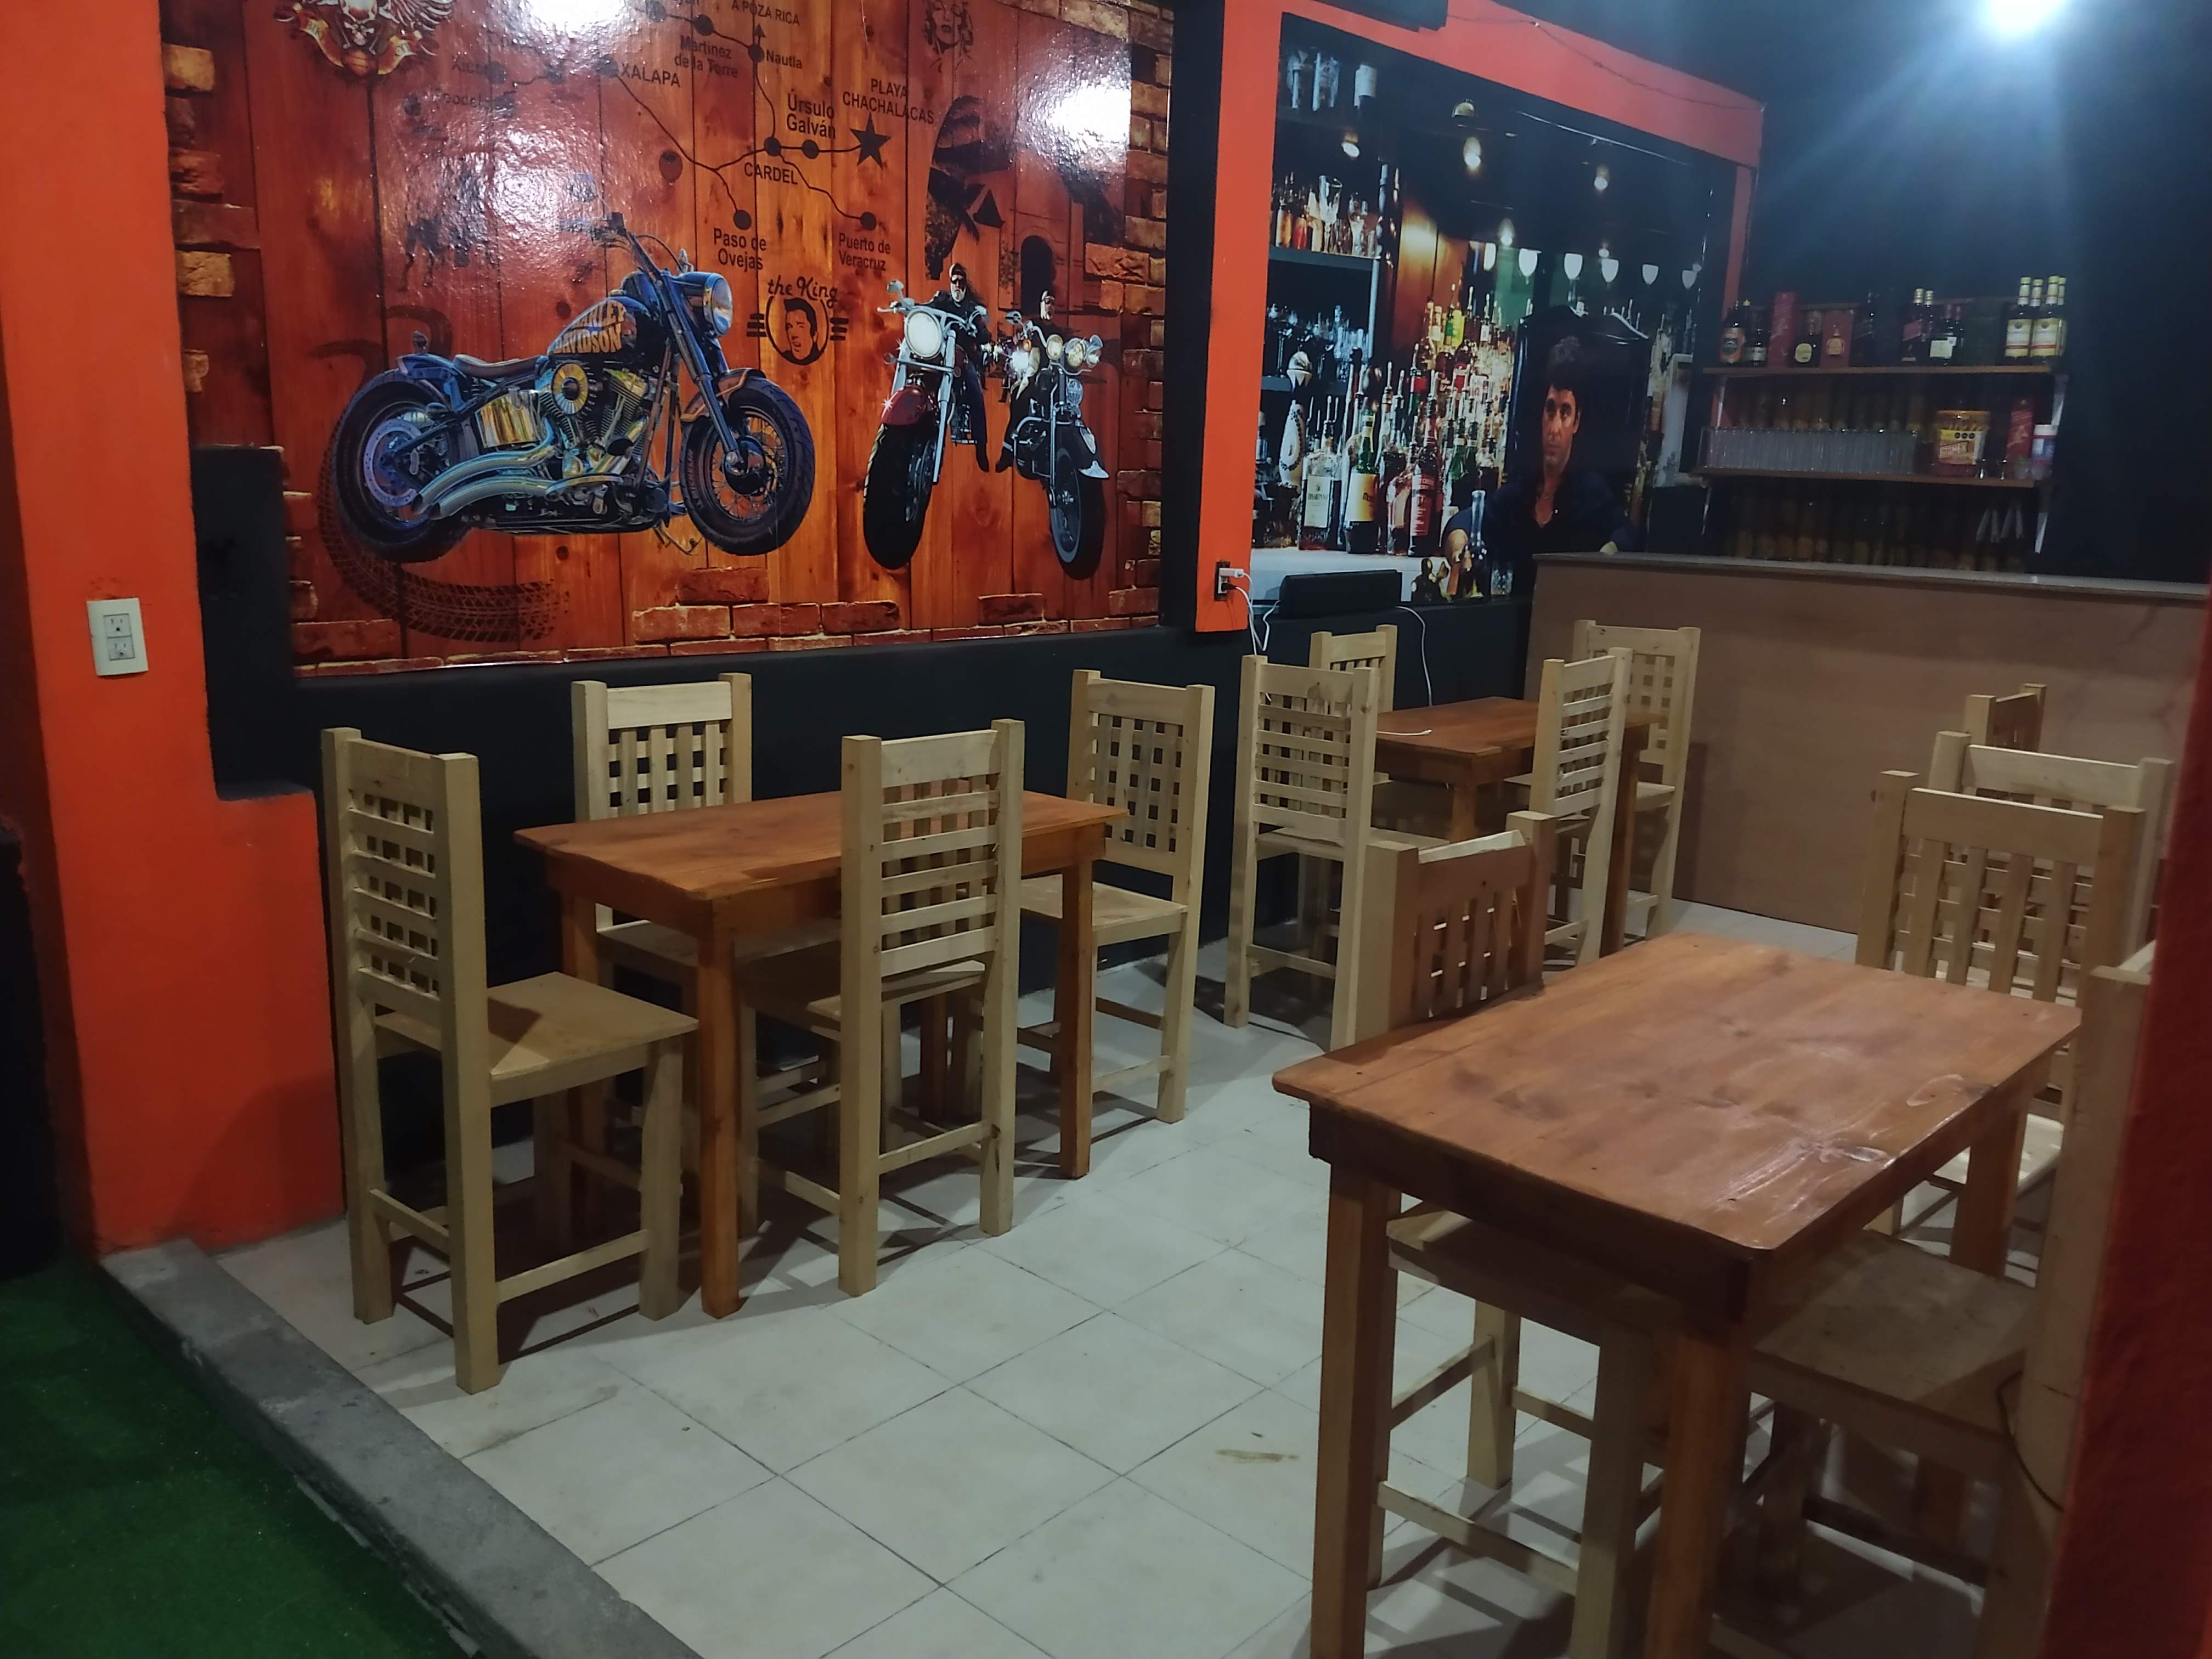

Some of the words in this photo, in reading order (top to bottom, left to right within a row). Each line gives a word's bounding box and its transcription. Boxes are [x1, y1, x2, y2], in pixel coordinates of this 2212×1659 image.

[742, 1, 771, 19] POZA
[775, 8, 800, 26] RICA
[674, 53, 689, 67] de
[692, 55, 703, 71] la
[707, 58, 738, 78] Torre
[766, 50, 802, 69] Nautla
[622, 63, 680, 87] XALAPA
[871, 78, 906, 98] PLAYA
[787, 88, 834, 120] Úrsulo
[843, 91, 934, 125] CHACHALACAS
[787, 114, 836, 139] Galván
[744, 162, 798, 185] CARDEL
[714, 228, 747, 250] Paso
[751, 236, 766, 251] de
[839, 232, 874, 252] Puerto
[878, 240, 891, 255] de
[718, 249, 763, 272] Ovejas
[839, 250, 887, 272] Veracruz
[768, 275, 793, 296] the
[797, 276, 838, 309] King
[552, 322, 622, 354] DAVIDSON
